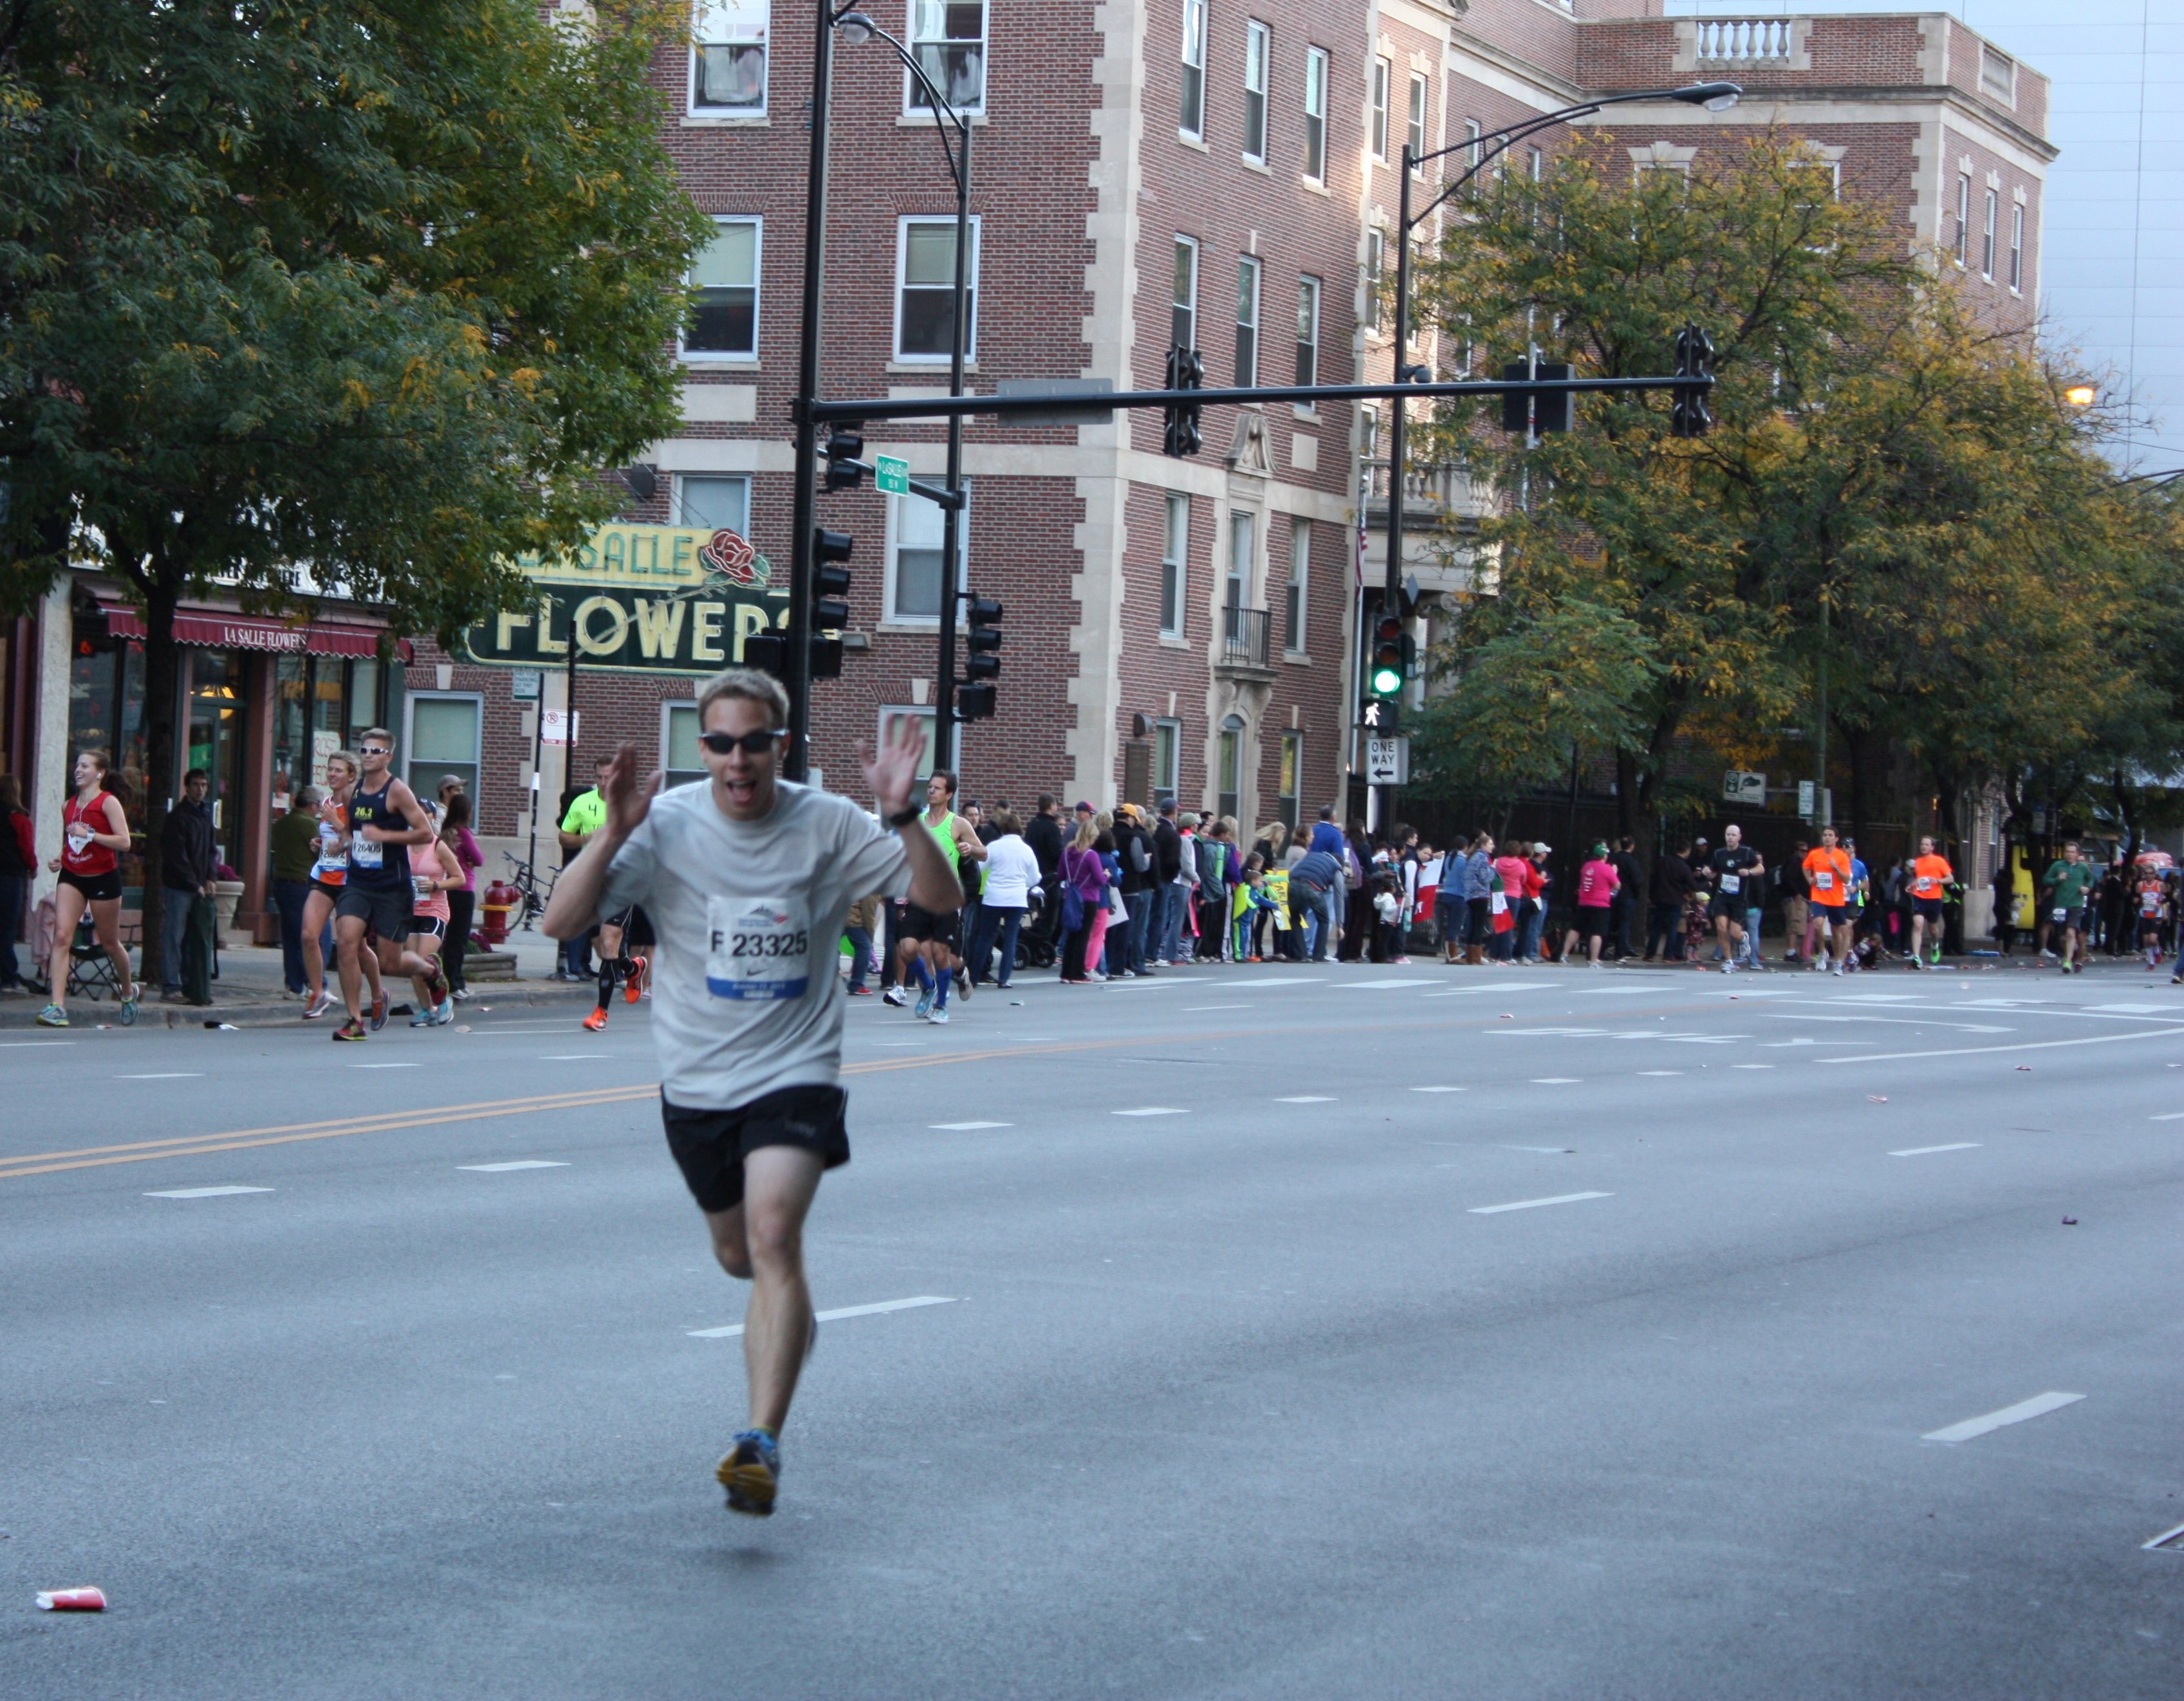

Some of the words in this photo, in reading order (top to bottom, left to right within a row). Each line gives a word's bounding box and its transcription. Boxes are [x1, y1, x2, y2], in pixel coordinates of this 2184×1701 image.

[224, 626, 237, 643] LA
[237, 628, 265, 646] SALLE
[1371, 741, 1394, 752] ONE
[1371, 754, 1395, 765] WAY
[355, 806, 373, 818] 26.2
[357, 843, 381, 853] 26405
[712, 930, 724, 953] F
[732, 930, 808, 957] 23325
